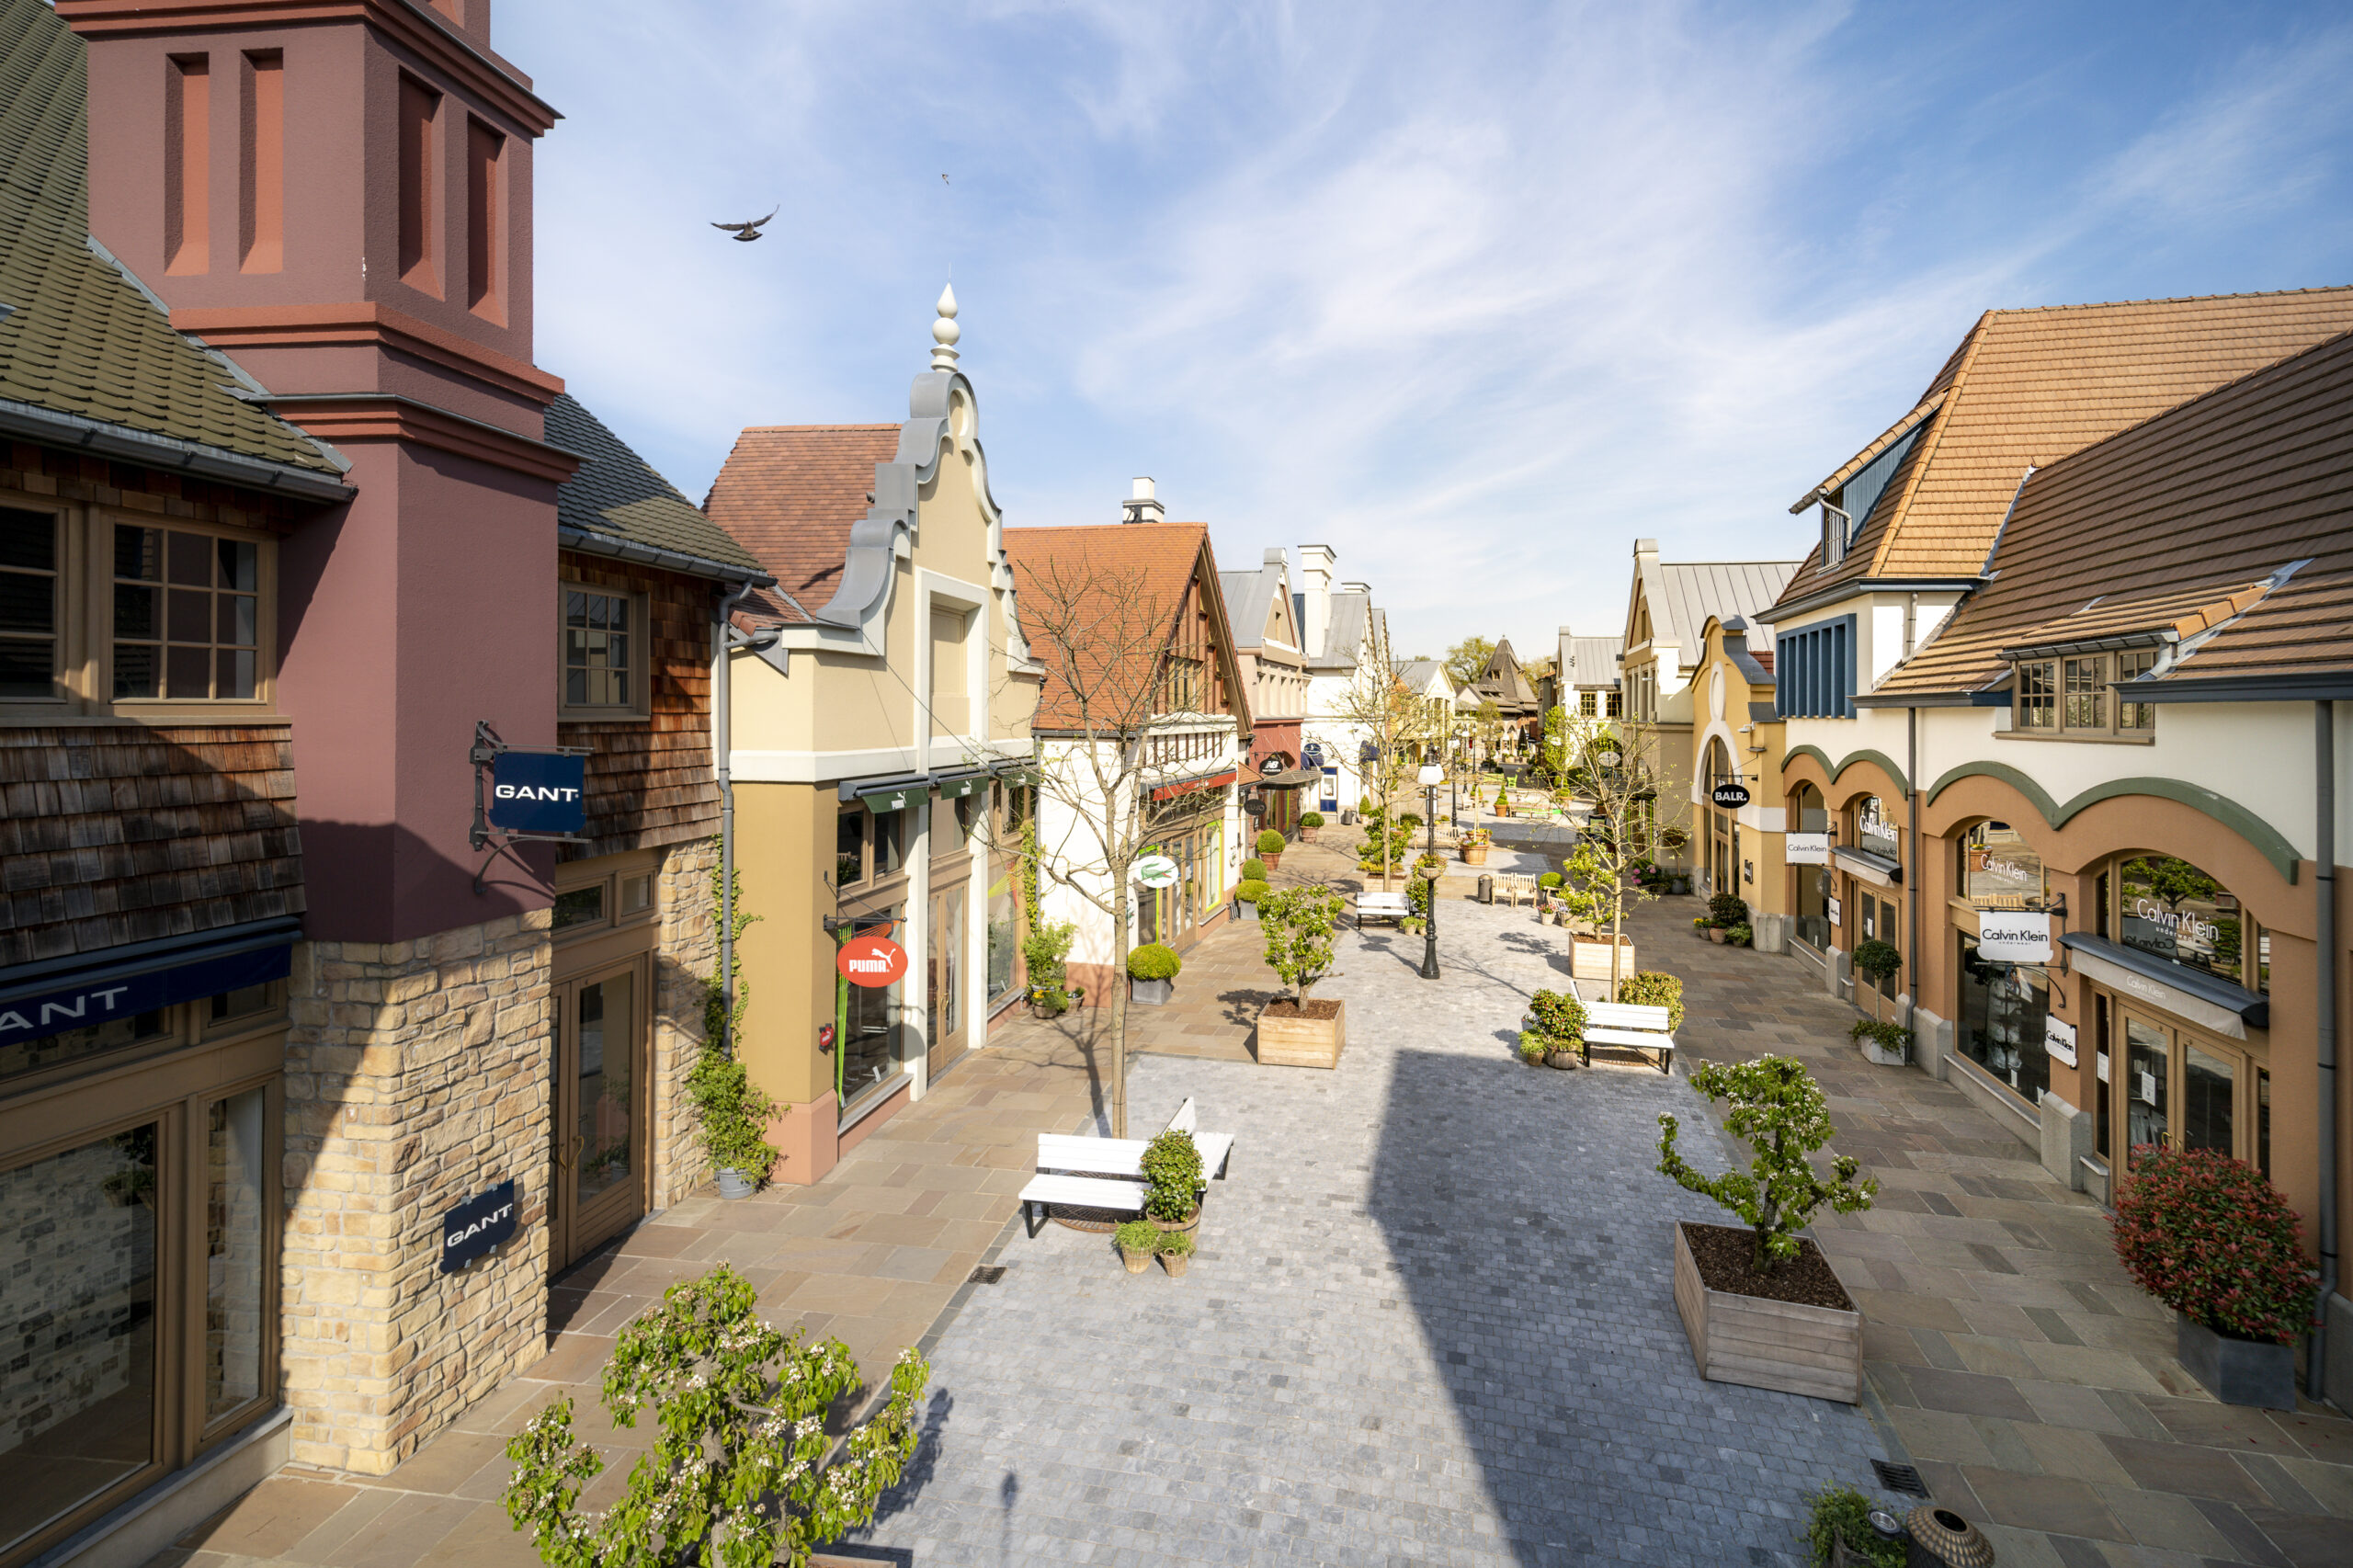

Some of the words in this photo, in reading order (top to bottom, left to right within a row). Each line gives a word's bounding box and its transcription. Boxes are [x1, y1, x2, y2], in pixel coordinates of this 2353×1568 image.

[495, 784, 579, 802] GANT
[1715, 791, 1747, 802] BALR.
[1788, 844, 1810, 853] Calvin
[1810, 845, 1827, 853] Klein
[1981, 854, 2006, 876] Calvin
[2006, 859, 2028, 882] Klein
[2137, 899, 2179, 929] Calvin
[2182, 909, 2219, 941] Klein
[1983, 928, 2018, 941] Calvin
[2019, 929, 2048, 942] Klein
[2155, 926, 2193, 942] underwea
[0, 986, 128, 1029] ANT
[448, 1203, 513, 1247] GANT
